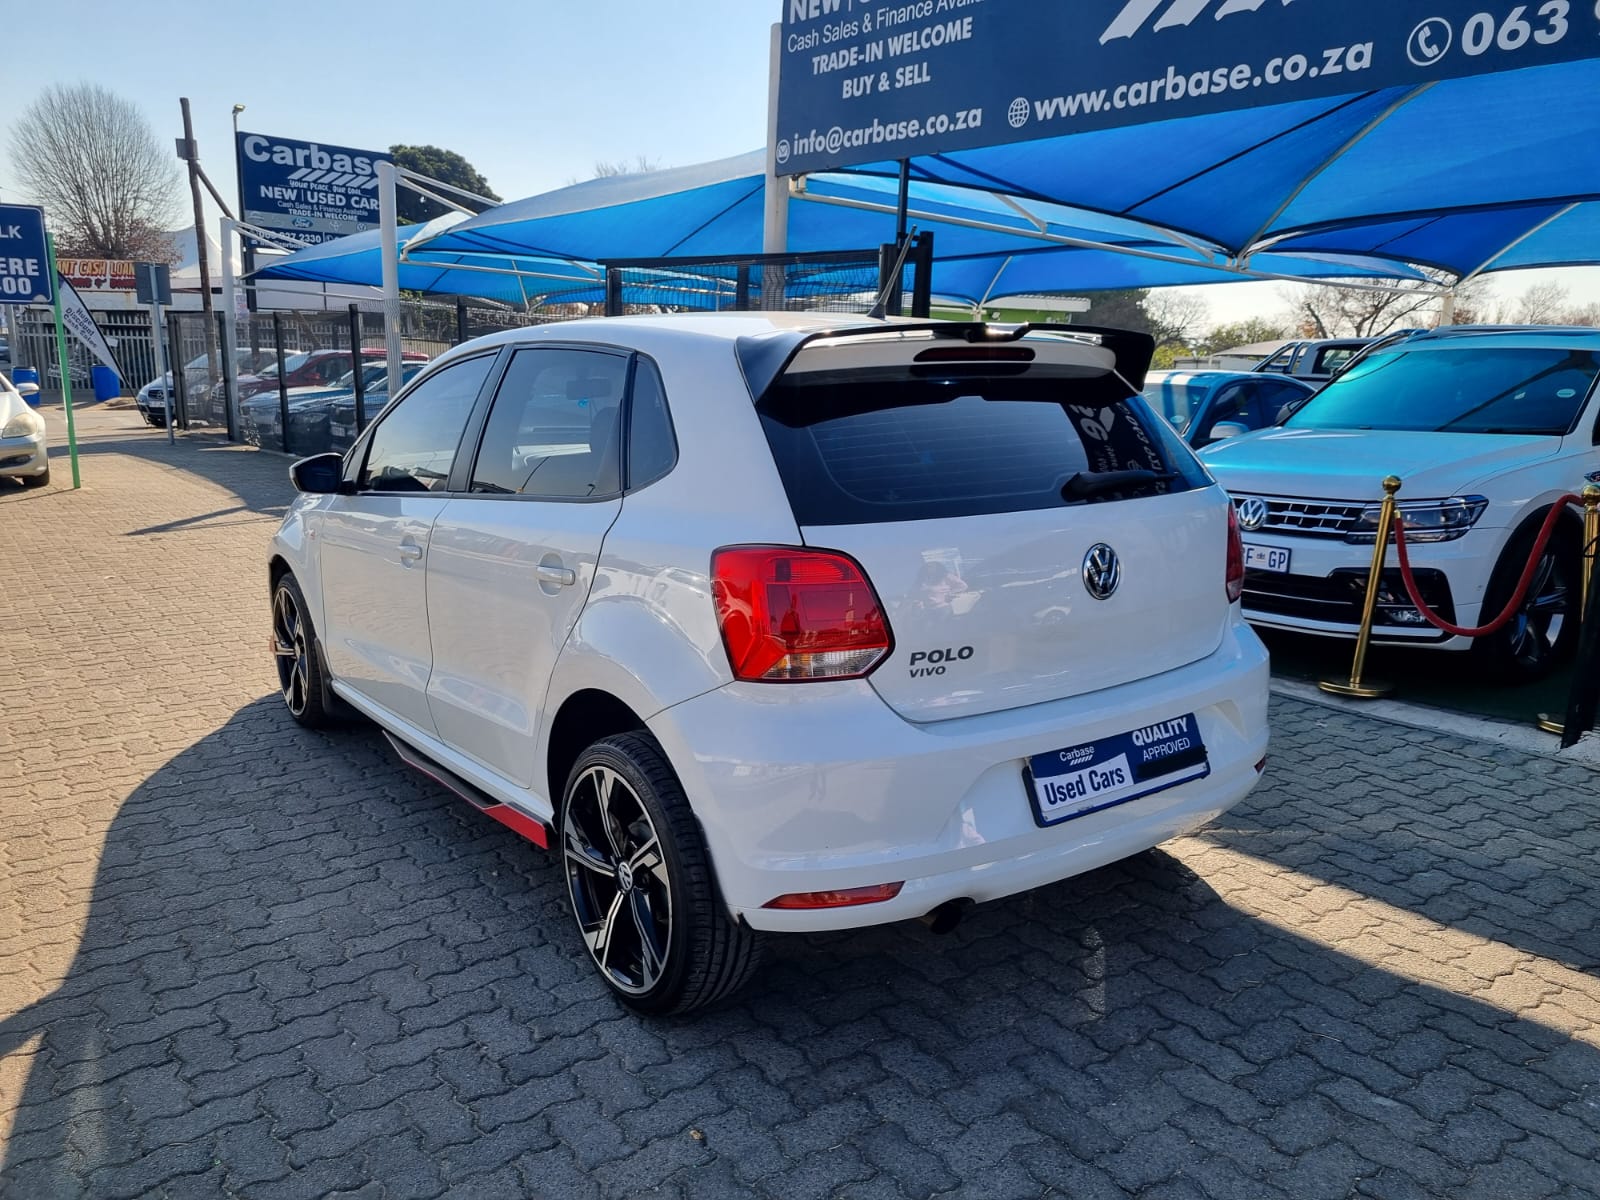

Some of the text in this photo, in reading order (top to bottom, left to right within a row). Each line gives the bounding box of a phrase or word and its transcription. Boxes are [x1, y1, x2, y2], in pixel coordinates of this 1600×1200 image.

[788, 28, 819, 53] Cash
[822, 20, 859, 44] Sales
[862, 13, 873, 33] &
[876, 2, 933, 30] Finance
[1461, 0, 1570, 56] 063
[812, 17, 973, 75] TRADE-IN WELCOME
[842, 62, 931, 99] BUY & SELL
[1034, 41, 1374, 122] www.carbase.co.za
[793, 107, 983, 156] info@carbase.co.za
[260, 185, 380, 211] NEW USED CAR
[288, 208, 358, 221] TRADE-IN WELCOME
[79, 260, 107, 276] CASH
[0, 277, 32, 295] 00
[65, 307, 95, 336] Discount
[76, 307, 92, 326] Huge
[1268, 551, 1287, 569] GP
[909, 646, 974, 666] POLO
[909, 665, 946, 678] VIVO
[1132, 717, 1189, 746] QUALITY
[1059, 745, 1095, 762] Carbase
[1143, 737, 1191, 762] APPROVED
[1043, 767, 1126, 805] Used Cars
